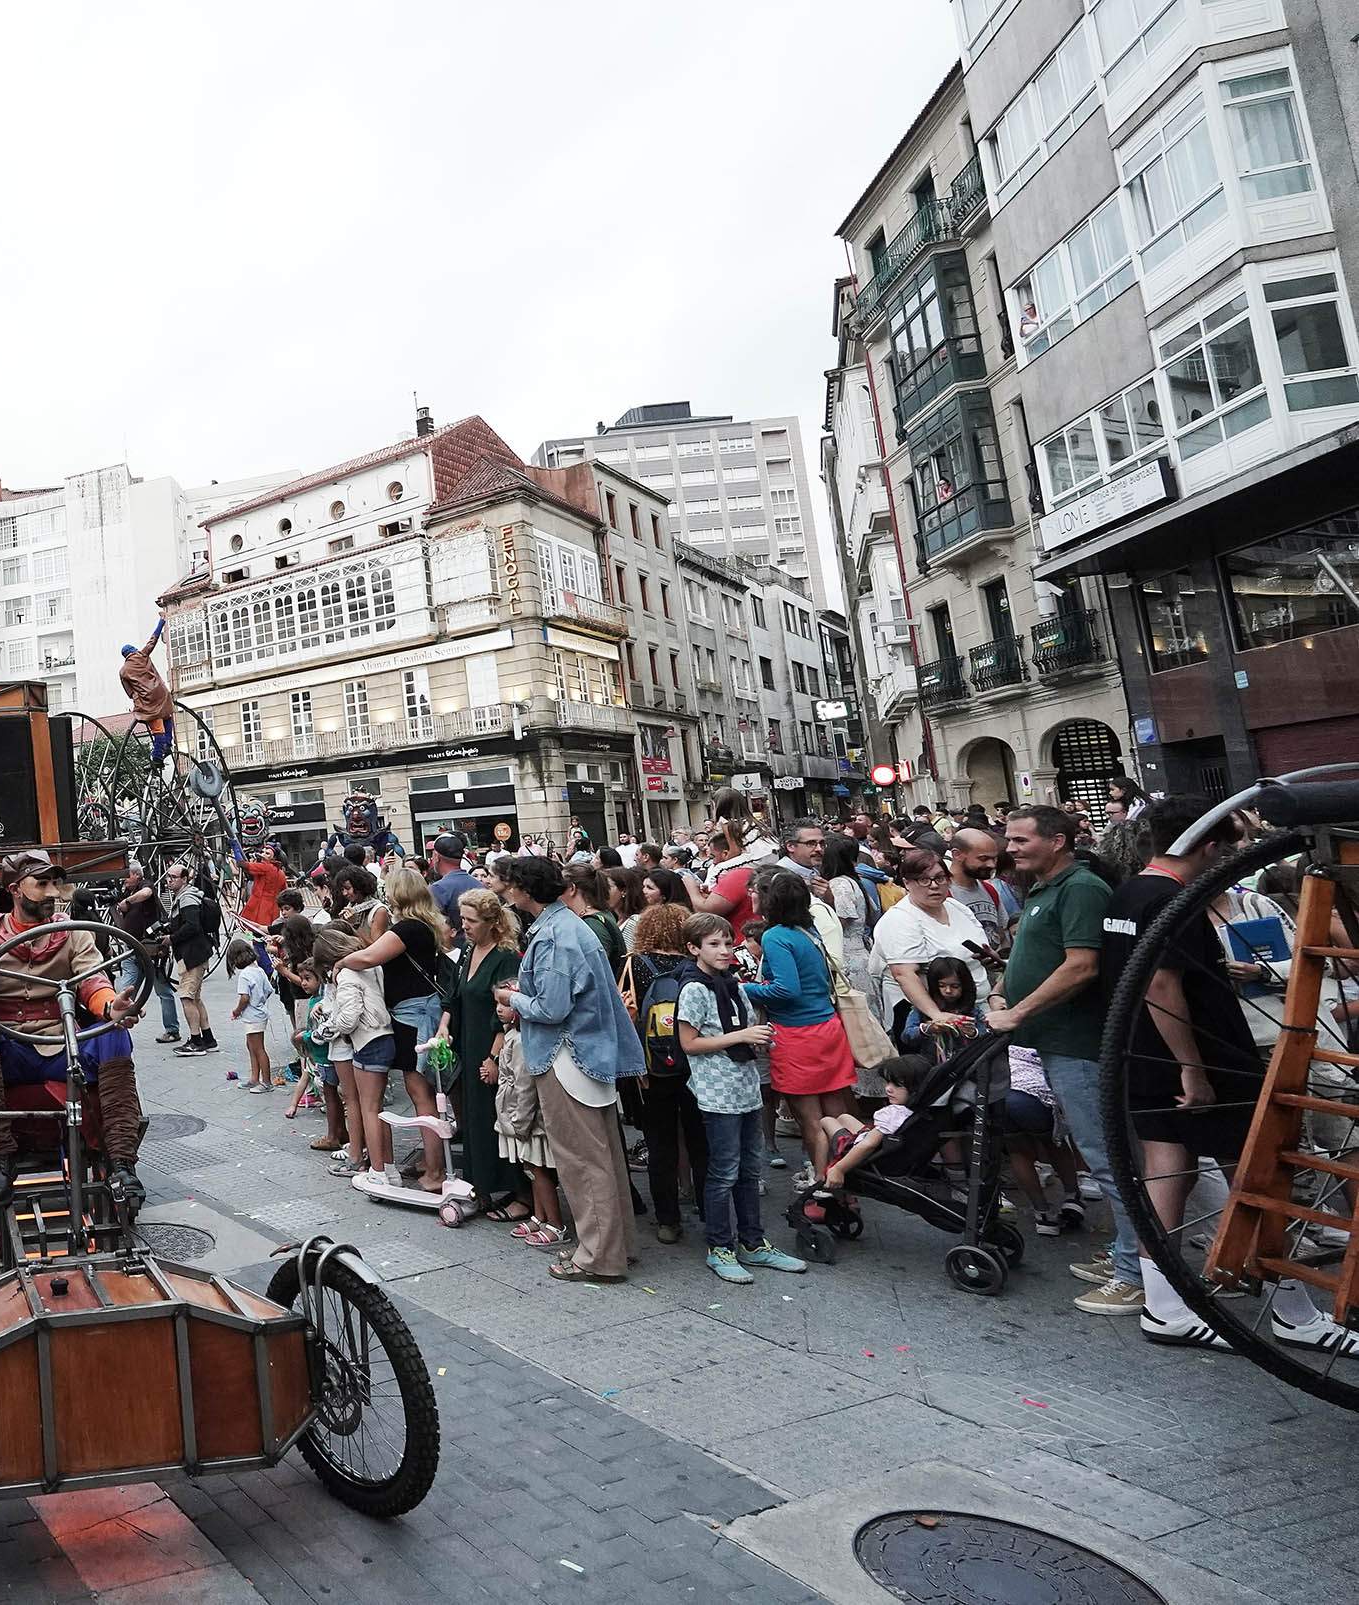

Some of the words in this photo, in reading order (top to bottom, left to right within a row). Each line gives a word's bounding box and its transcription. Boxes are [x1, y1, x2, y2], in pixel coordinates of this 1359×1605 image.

[1058, 503, 1091, 535] LOME
[501, 525, 522, 616] FENOGAL
[581, 785, 595, 795] Orange
[970, 1091, 986, 1168] LITEWAY
